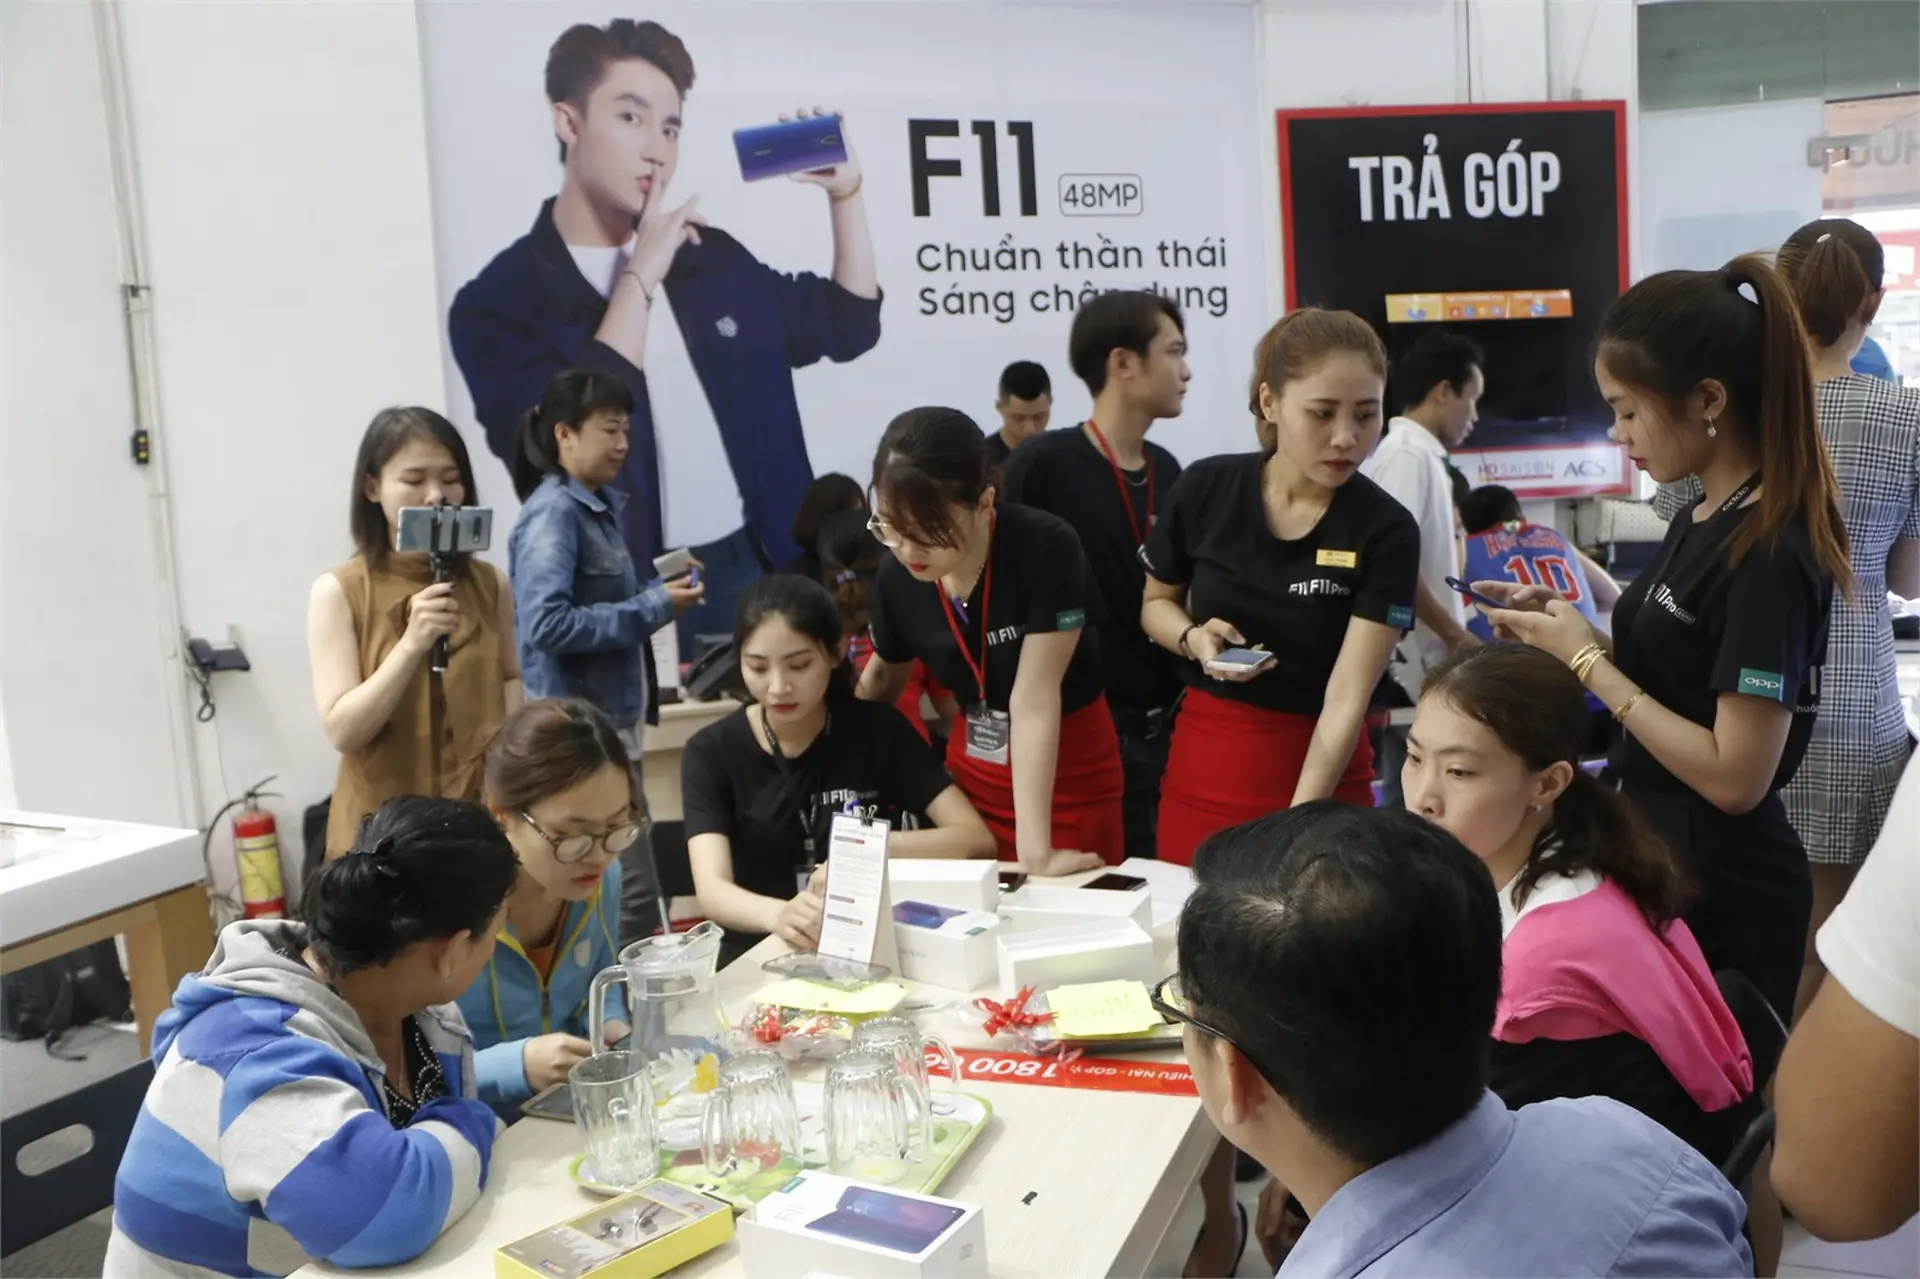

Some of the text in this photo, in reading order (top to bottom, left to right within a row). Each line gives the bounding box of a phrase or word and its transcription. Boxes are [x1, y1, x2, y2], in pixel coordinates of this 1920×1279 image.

[907, 118, 1038, 217] F11
[1349, 133, 1561, 222] TRẢ GÓP
[1063, 183, 1139, 207] 48MP
[916, 231, 1228, 272] Chuẩn thần thái
[919, 282, 1015, 324] Sáng
[1030, 280, 1120, 312] châ
[1563, 459, 1607, 477] ACS
[1503, 554, 1583, 603] 10
[968, 1057, 1059, 1079] 1800
